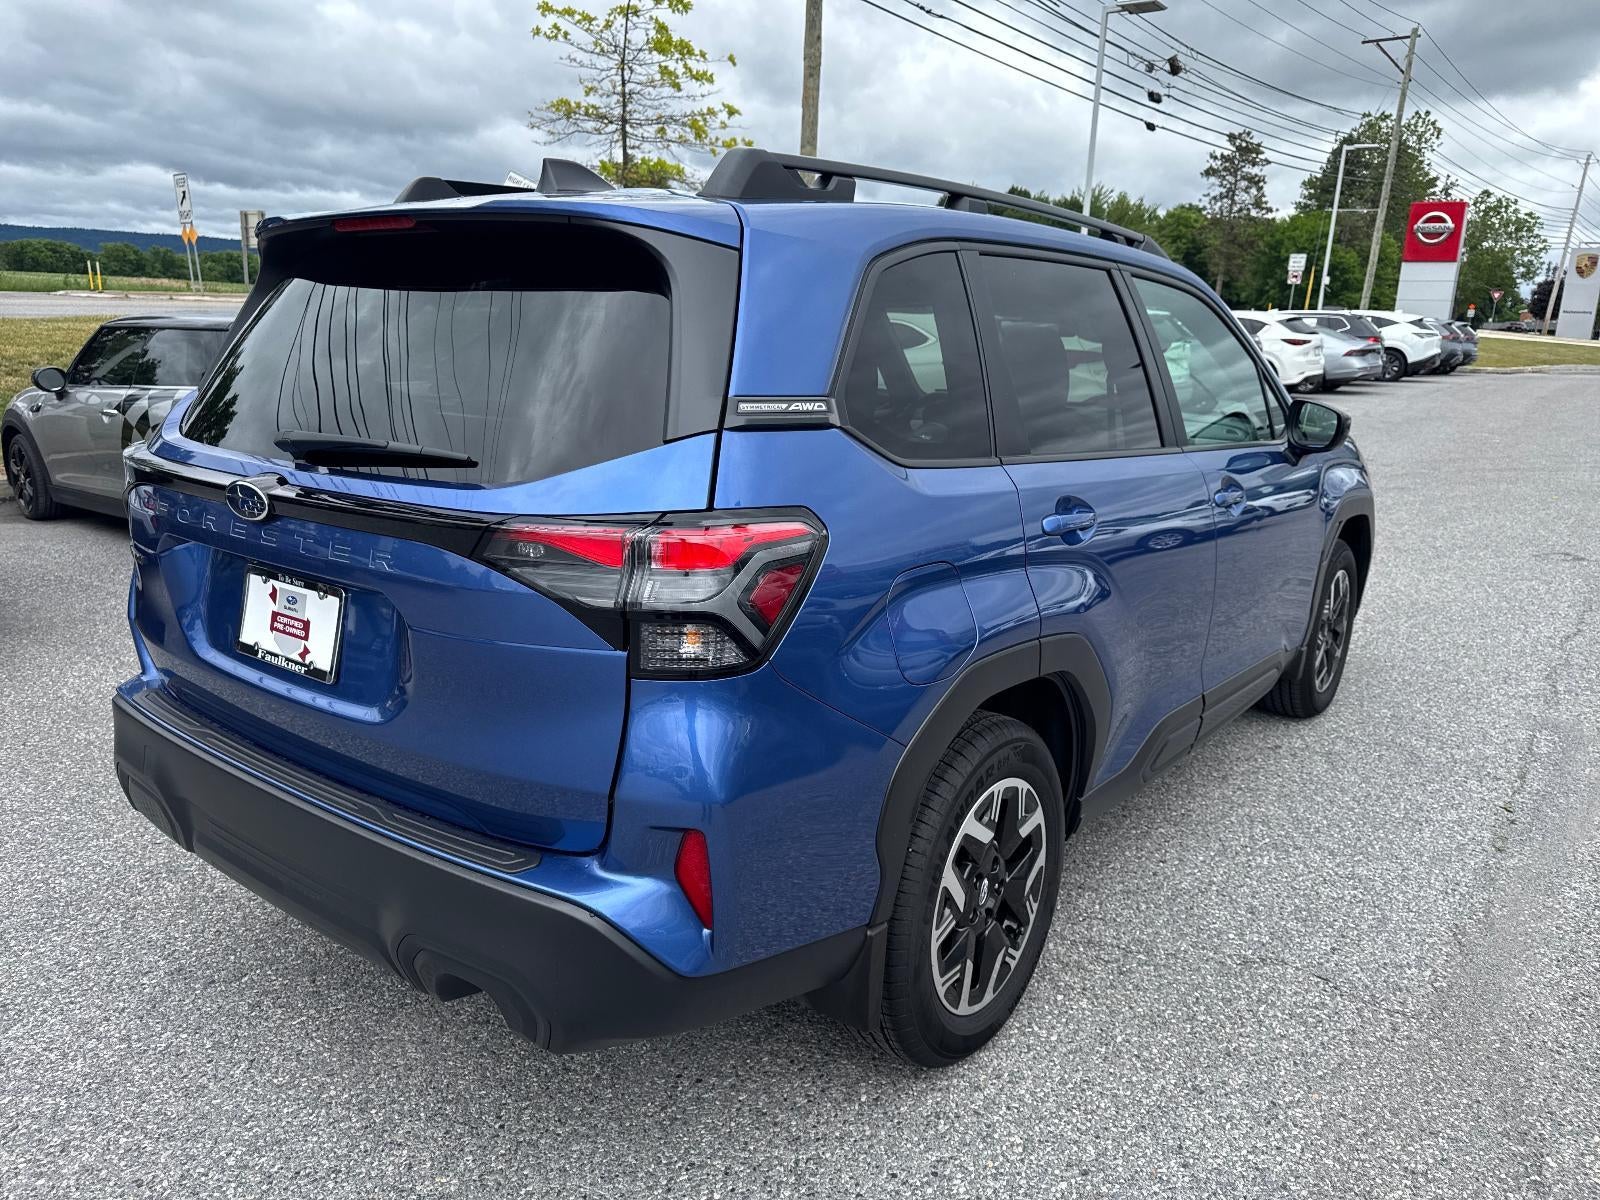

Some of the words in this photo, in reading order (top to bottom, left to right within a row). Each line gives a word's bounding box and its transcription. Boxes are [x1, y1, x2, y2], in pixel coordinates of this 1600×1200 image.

[1416, 224, 1451, 232] NISSAN
[740, 403, 785, 411] SYMMETRICAL
[788, 402, 827, 411] AWD
[158, 500, 395, 572] FORESTER
[278, 573, 284, 581] To
[285, 575, 292, 584] Be
[292, 577, 305, 588] Sure
[273, 621, 306, 638] PRE-OWNED
[276, 615, 304, 629] CERTIFIED
[256, 647, 308, 675] Faulkner
